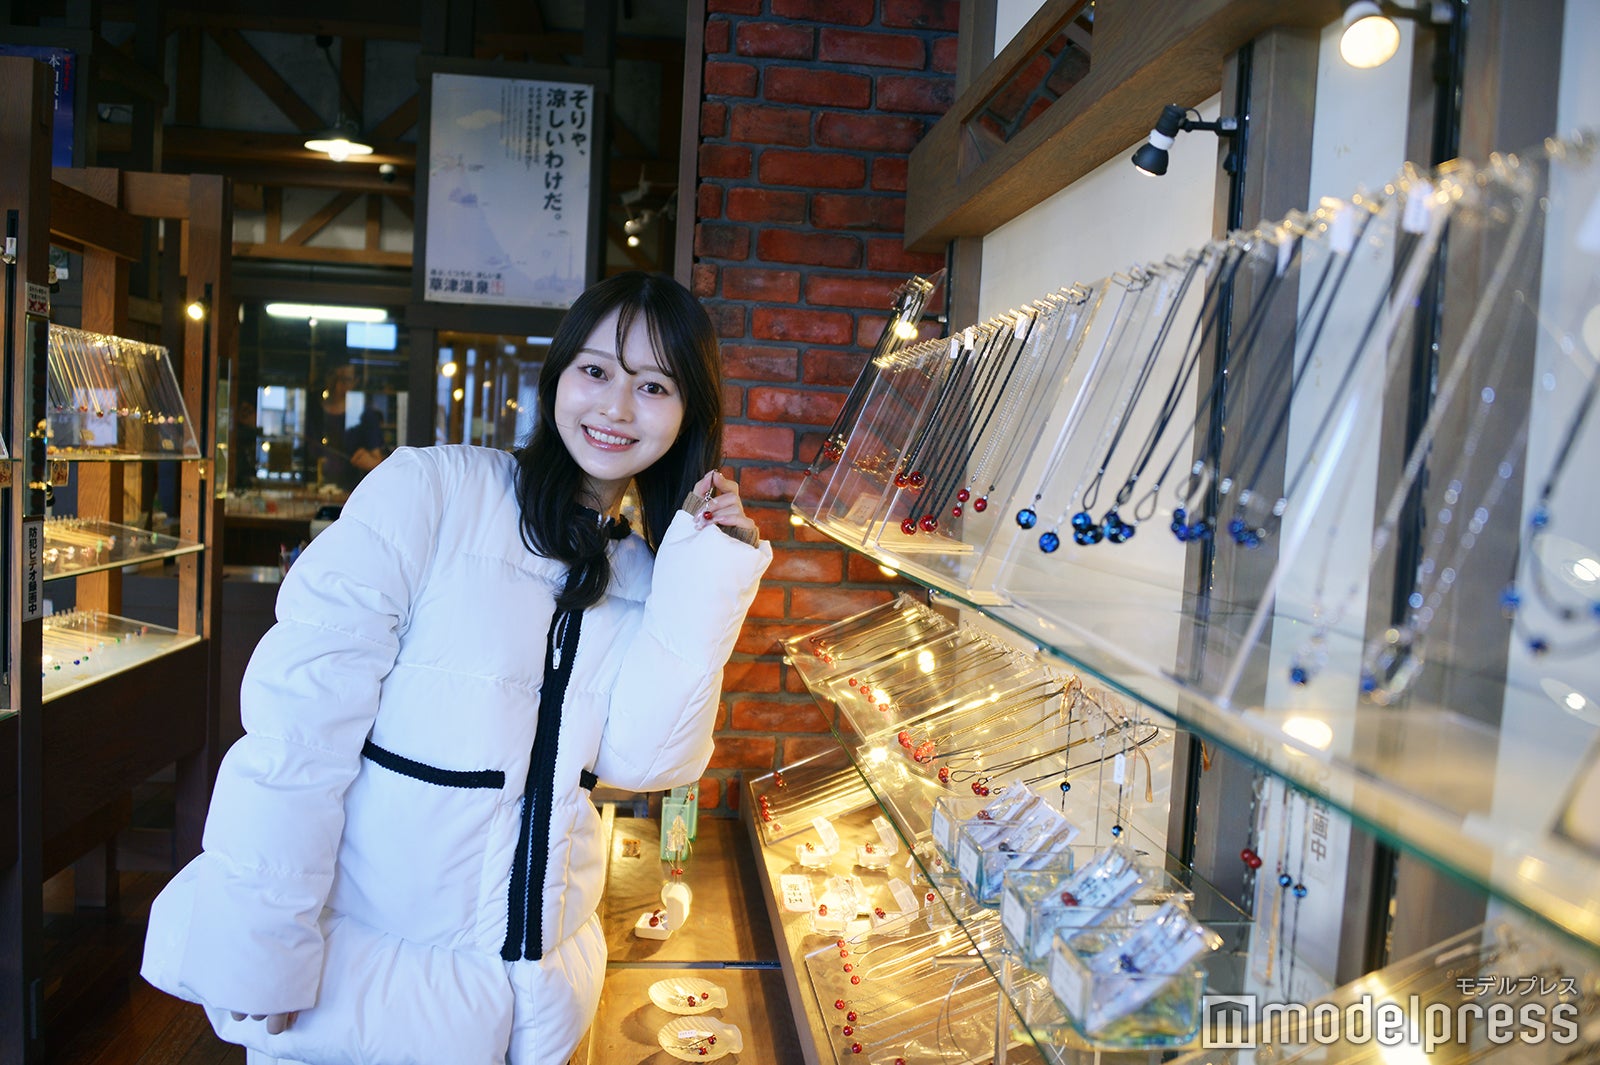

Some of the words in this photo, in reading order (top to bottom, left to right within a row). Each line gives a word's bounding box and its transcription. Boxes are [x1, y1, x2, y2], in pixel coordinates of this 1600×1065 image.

[543, 87, 567, 220] 涼しいわけだ。
[570, 89, 588, 156] そりゃ、
[430, 277, 488, 295] 草津温泉
